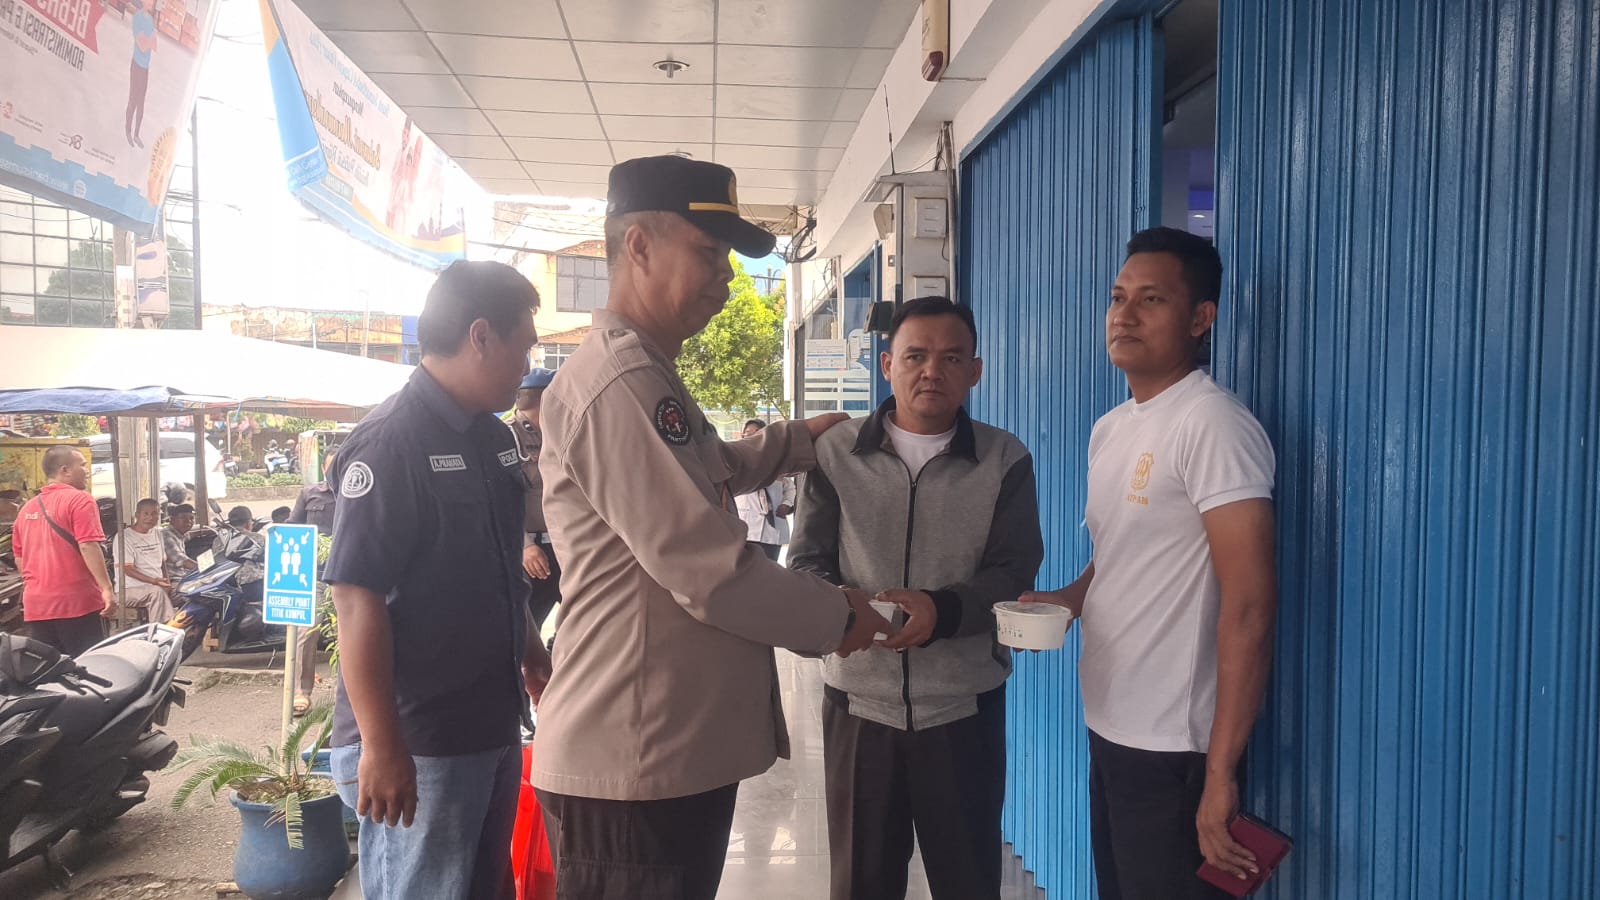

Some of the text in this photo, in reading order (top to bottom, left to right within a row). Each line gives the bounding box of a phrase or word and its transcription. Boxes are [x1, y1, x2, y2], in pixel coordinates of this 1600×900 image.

[268, 595, 310, 609] ASSEMBLY POINT
[272, 607, 306, 621] TITIK KUMPUL
